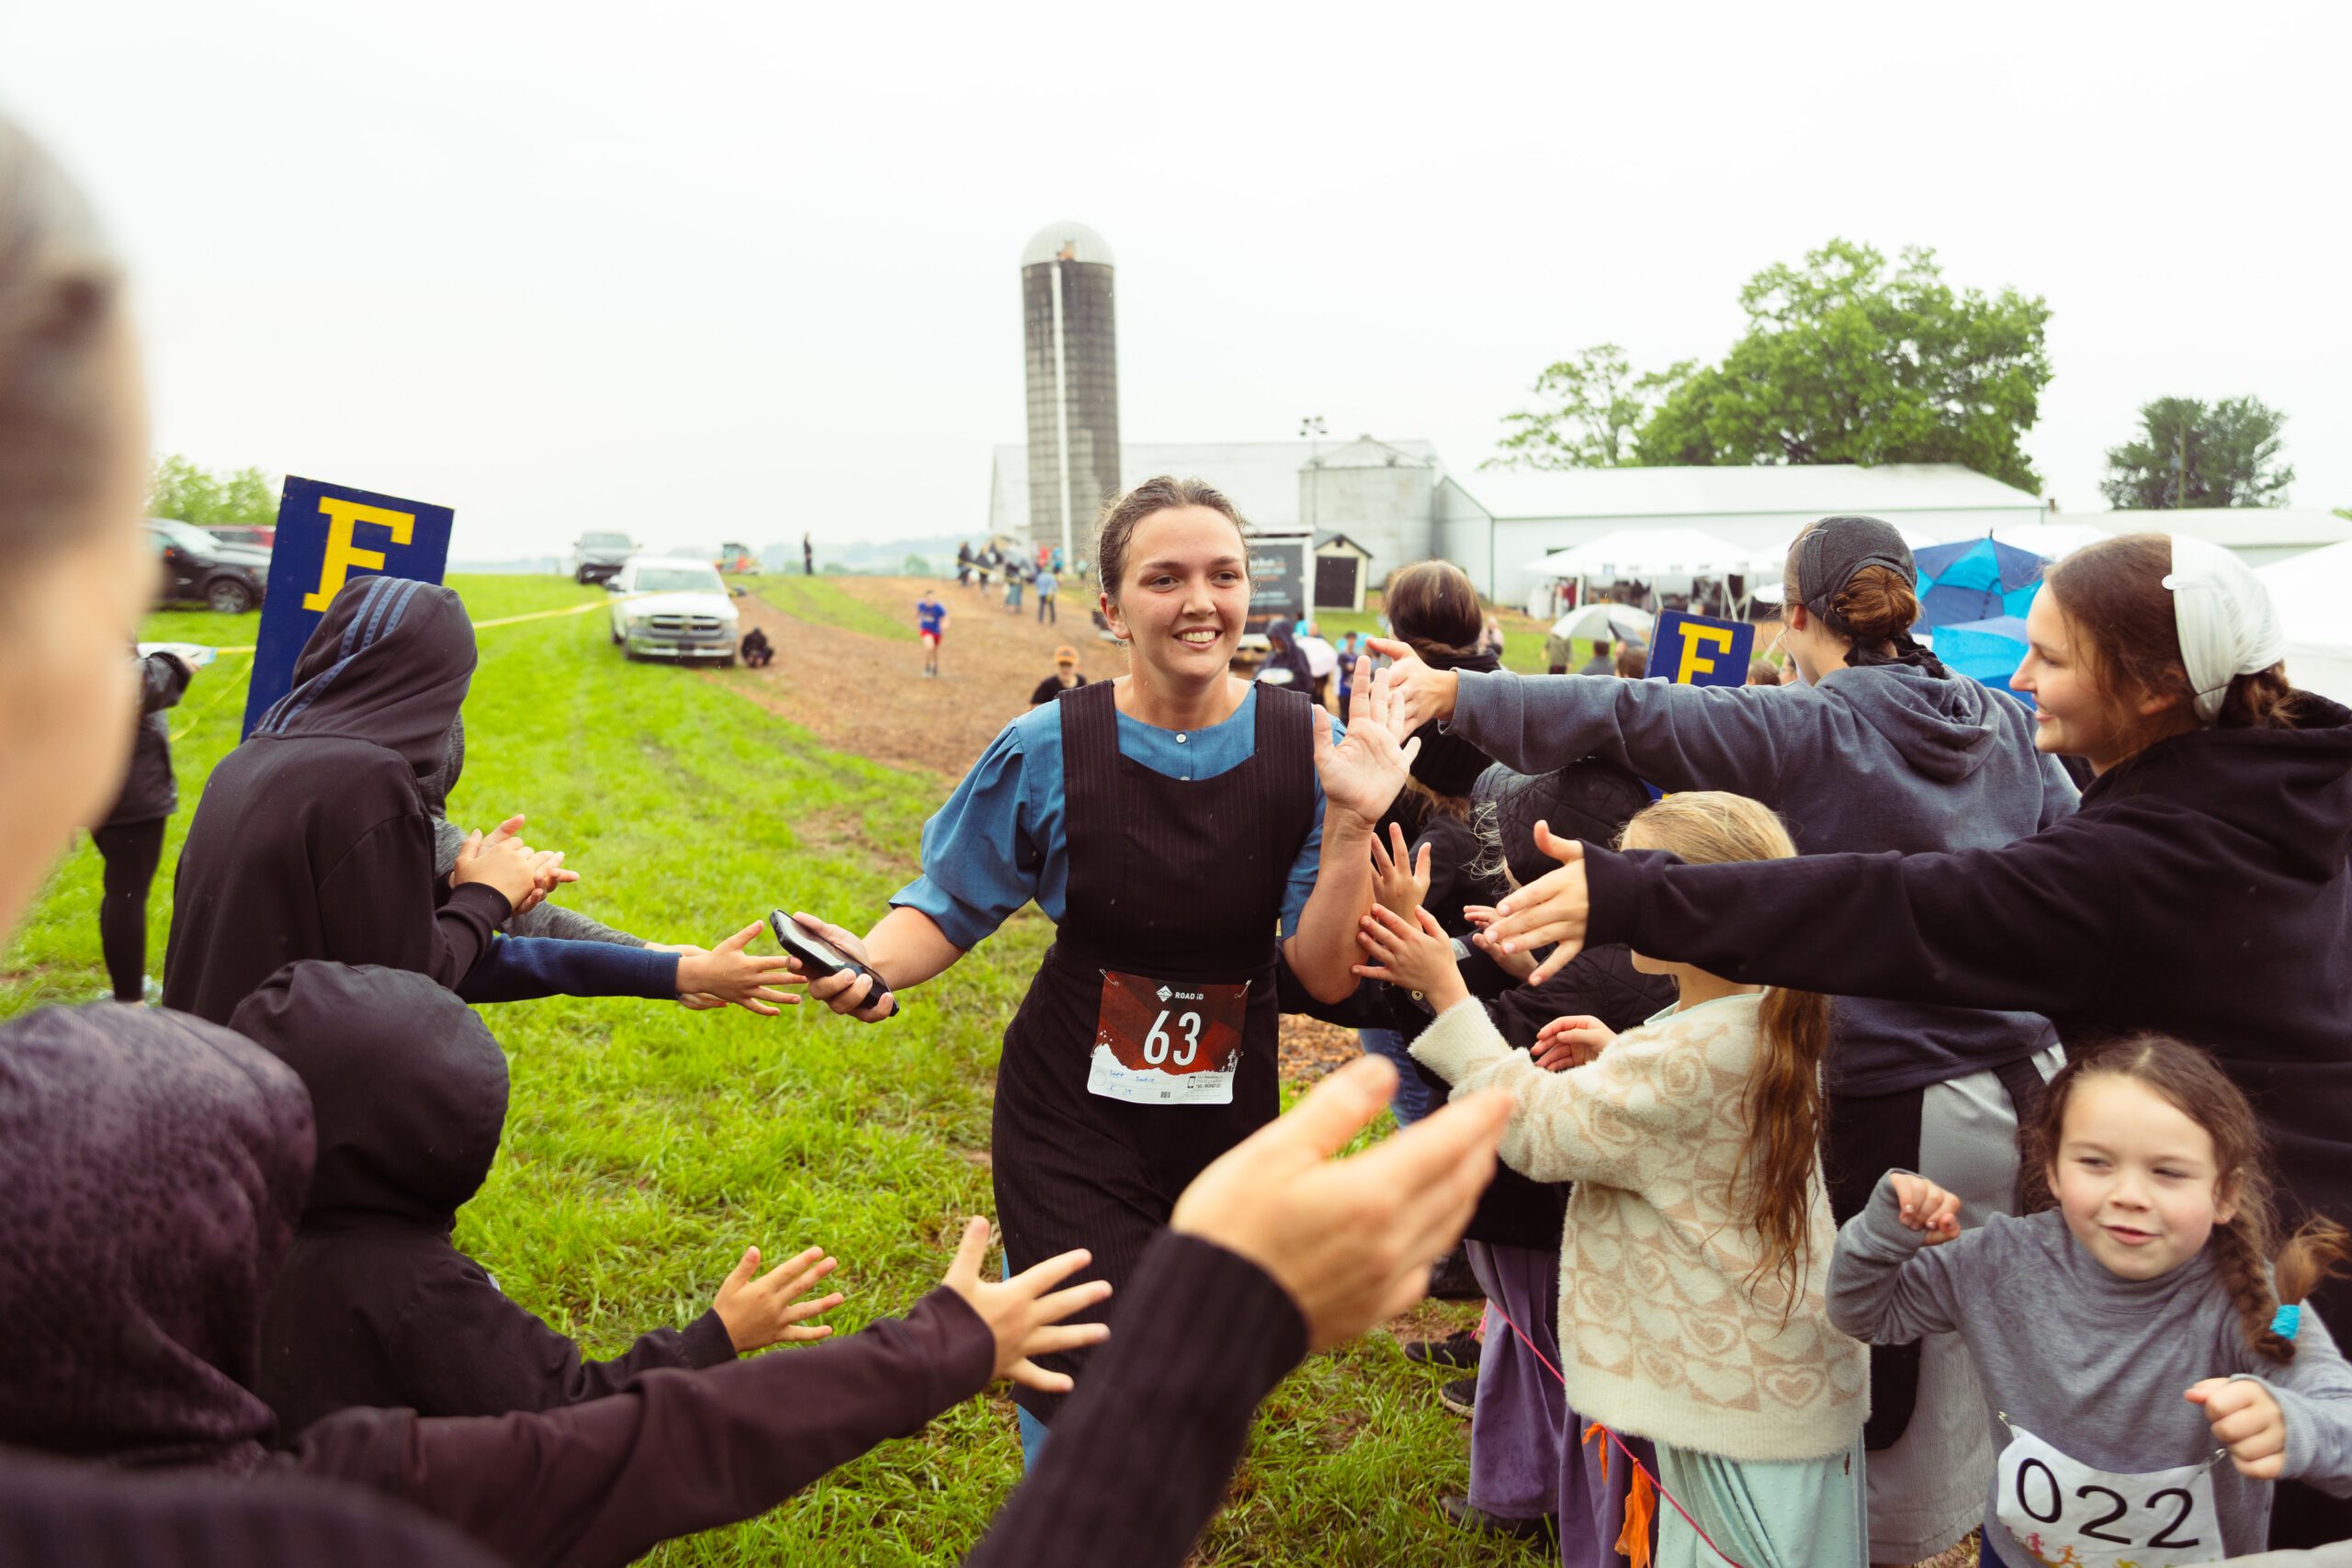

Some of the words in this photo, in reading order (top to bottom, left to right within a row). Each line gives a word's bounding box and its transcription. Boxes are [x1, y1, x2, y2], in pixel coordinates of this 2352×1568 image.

[302, 496, 415, 613] F
[1677, 622, 1734, 685] F
[1174, 992, 1194, 1000] ROAD
[1144, 1010, 1201, 1066] 63
[2017, 1458, 2199, 1549] 022
